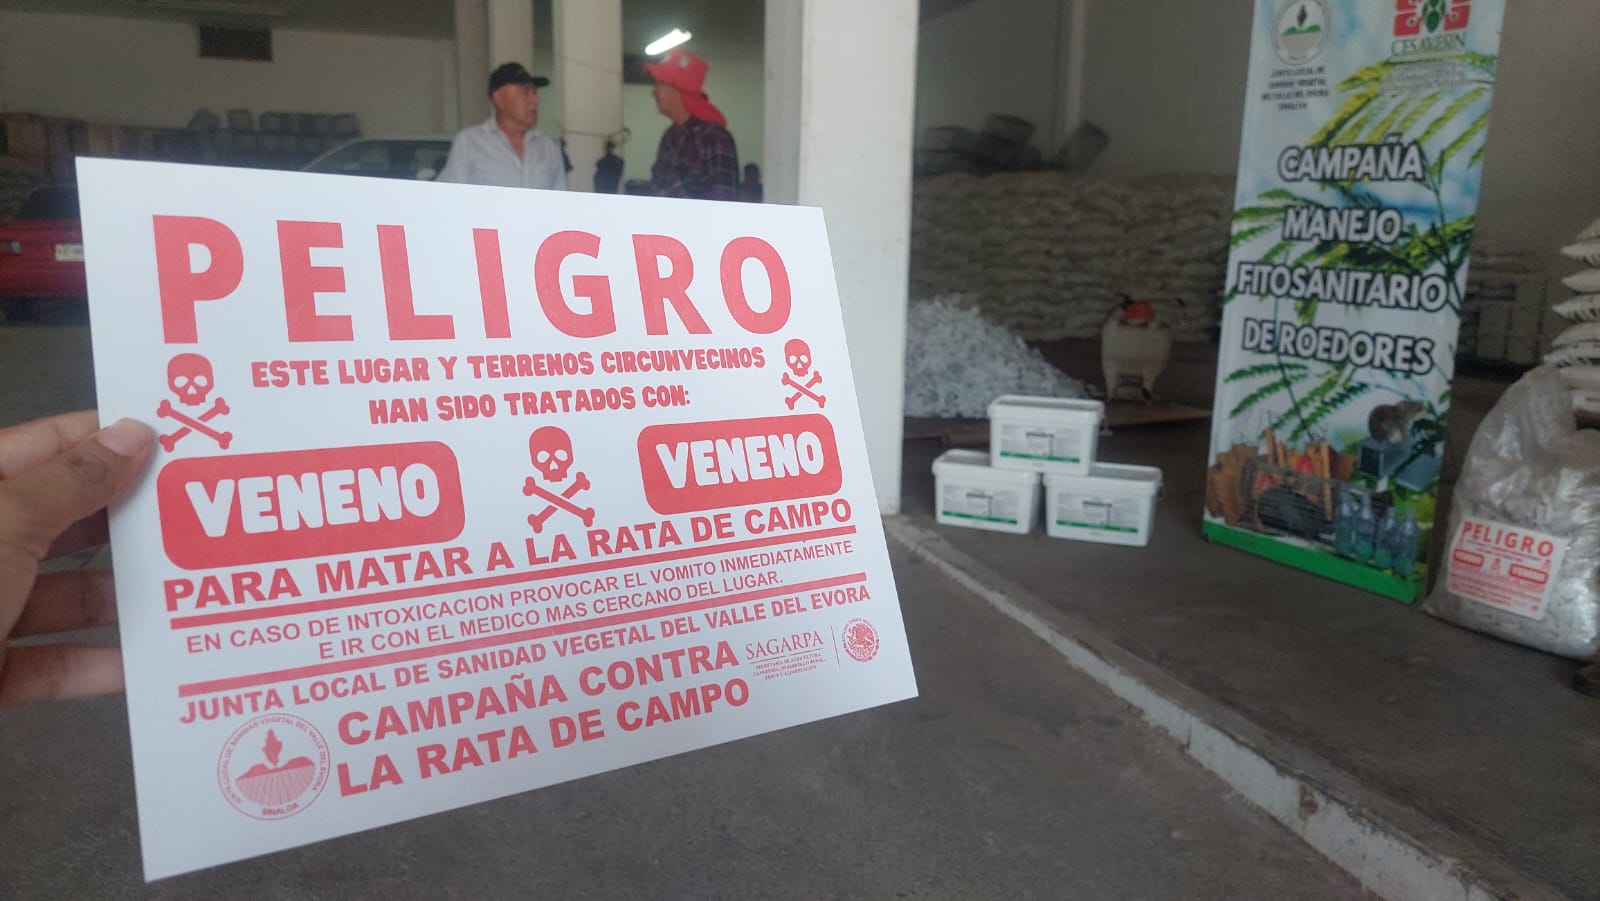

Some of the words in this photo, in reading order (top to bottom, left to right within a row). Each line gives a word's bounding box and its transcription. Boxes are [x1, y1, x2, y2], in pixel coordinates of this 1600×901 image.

[1279, 134, 1425, 182] CAMPAÑA
[1283, 206, 1403, 243] MANEJO
[153, 214, 791, 344] PELIGRO
[1238, 262, 1448, 312] FITOSANITARIO
[251, 360, 328, 388] ESTE
[338, 358, 430, 384] LUGAR
[438, 356, 457, 380] Y
[467, 351, 594, 378] TERRENOS
[601, 347, 765, 374] CIRCUNVECINOS
[1242, 318, 1277, 352] DE
[1279, 322, 1434, 374] ROEDORES
[369, 399, 428, 424] HAN
[436, 394, 496, 420] SIDO
[504, 386, 636, 416] TRATADOS
[642, 384, 690, 409] CON:
[656, 432, 824, 488] VENENO
[185, 463, 440, 537] VENENO
[163, 567, 302, 612] PARA
[315, 546, 473, 594] MATAR
[486, 541, 514, 571] A
[525, 534, 576, 565] LA
[587, 521, 682, 557] RATA
[690, 513, 735, 542] DE
[744, 498, 852, 533] CAMPO
[1462, 521, 1554, 557] PELIGRO
[186, 633, 221, 654] EN
[230, 623, 301, 648] CASO
[308, 616, 341, 637] DE
[347, 591, 504, 632] INTOXICACION
[510, 576, 619, 608] PROVOCAR
[623, 573, 647, 589] EL
[650, 561, 716, 584] VOMITO
[720, 540, 853, 575] INMEDIATAMENTE
[318, 642, 334, 660] E
[341, 639, 364, 656] IR
[371, 629, 420, 651] CON
[427, 624, 455, 642] EL
[459, 610, 540, 637] MEDICO
[549, 603, 588, 623] MAS
[592, 587, 682, 616] CERCANO
[686, 582, 720, 601] DEL
[724, 570, 783, 594] LUGAR.
[180, 689, 284, 724] JUNTA
[292, 673, 386, 705] LOCAL
[394, 665, 429, 687] DE
[437, 645, 547, 680] SANIDAD
[552, 625, 656, 658] VEGETAL
[660, 616, 700, 639] DEL
[704, 603, 767, 629] VALLE
[771, 596, 807, 617] DEL
[812, 585, 871, 610] EVORA
[745, 630, 824, 660] SAGARPA
[337, 668, 568, 745] CAMPAÑA
[578, 640, 739, 697] CONTRA
[337, 753, 404, 797] LA
[416, 725, 538, 779] RATA
[549, 708, 605, 748] DE
[615, 678, 750, 732] CAMPO
[262, 803, 299, 815] SINALOA
